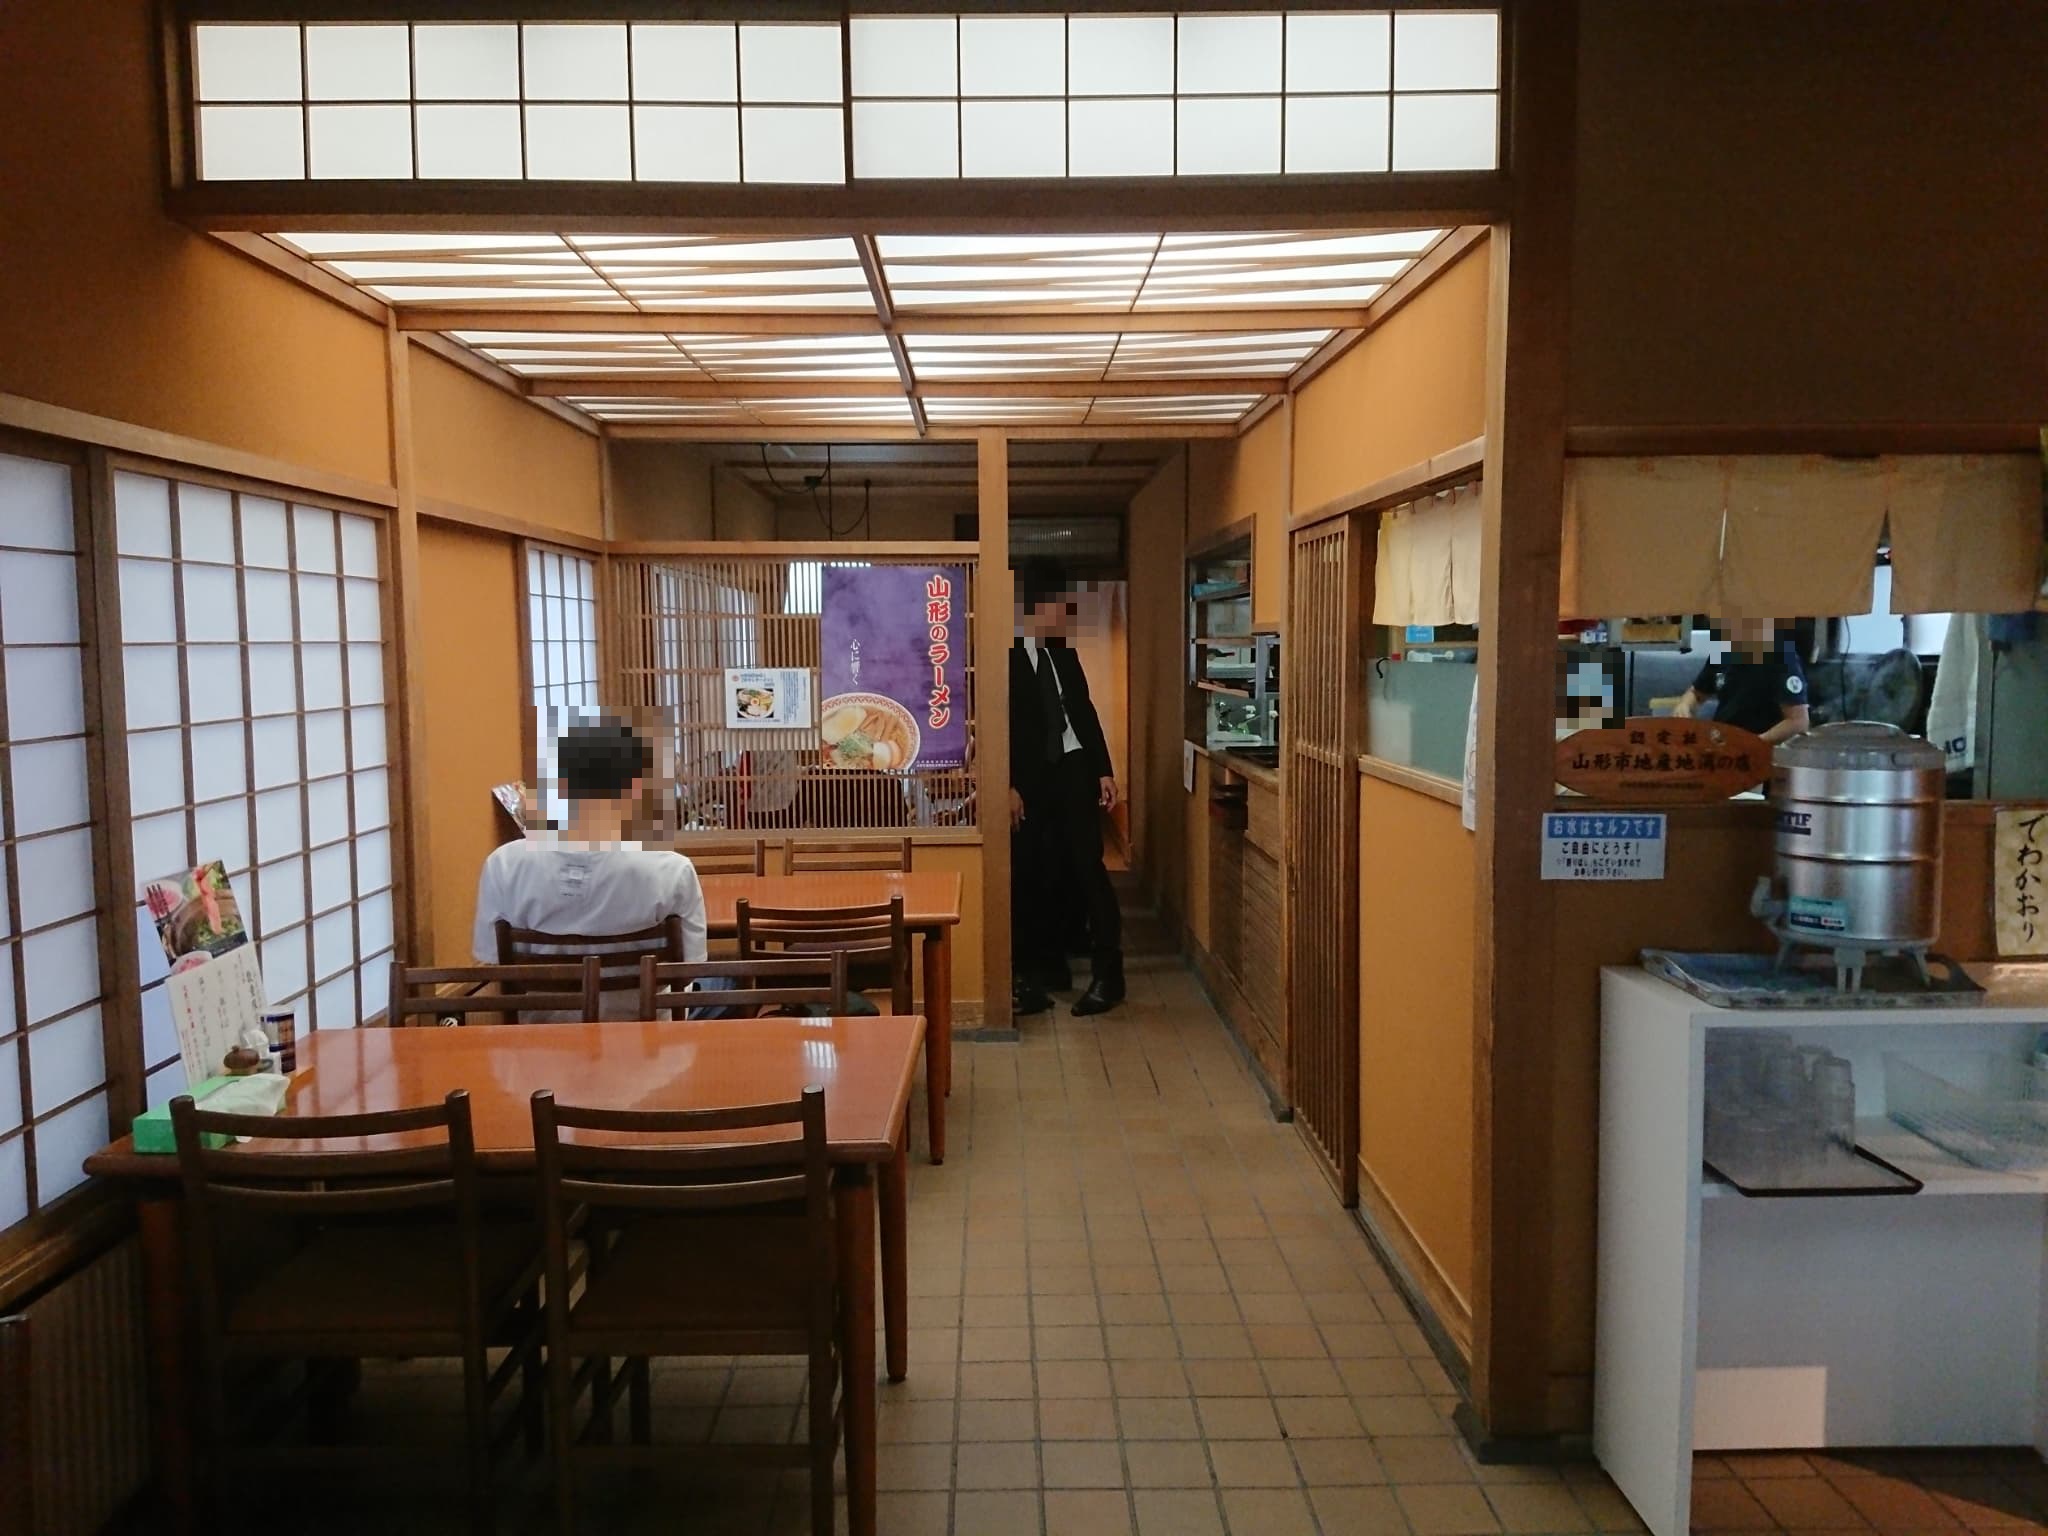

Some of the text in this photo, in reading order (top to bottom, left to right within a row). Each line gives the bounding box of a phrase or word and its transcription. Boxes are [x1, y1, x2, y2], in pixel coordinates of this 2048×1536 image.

[927, 575, 951, 729] 山形のラーメン
[1553, 819, 1656, 836] お水はセルフです
